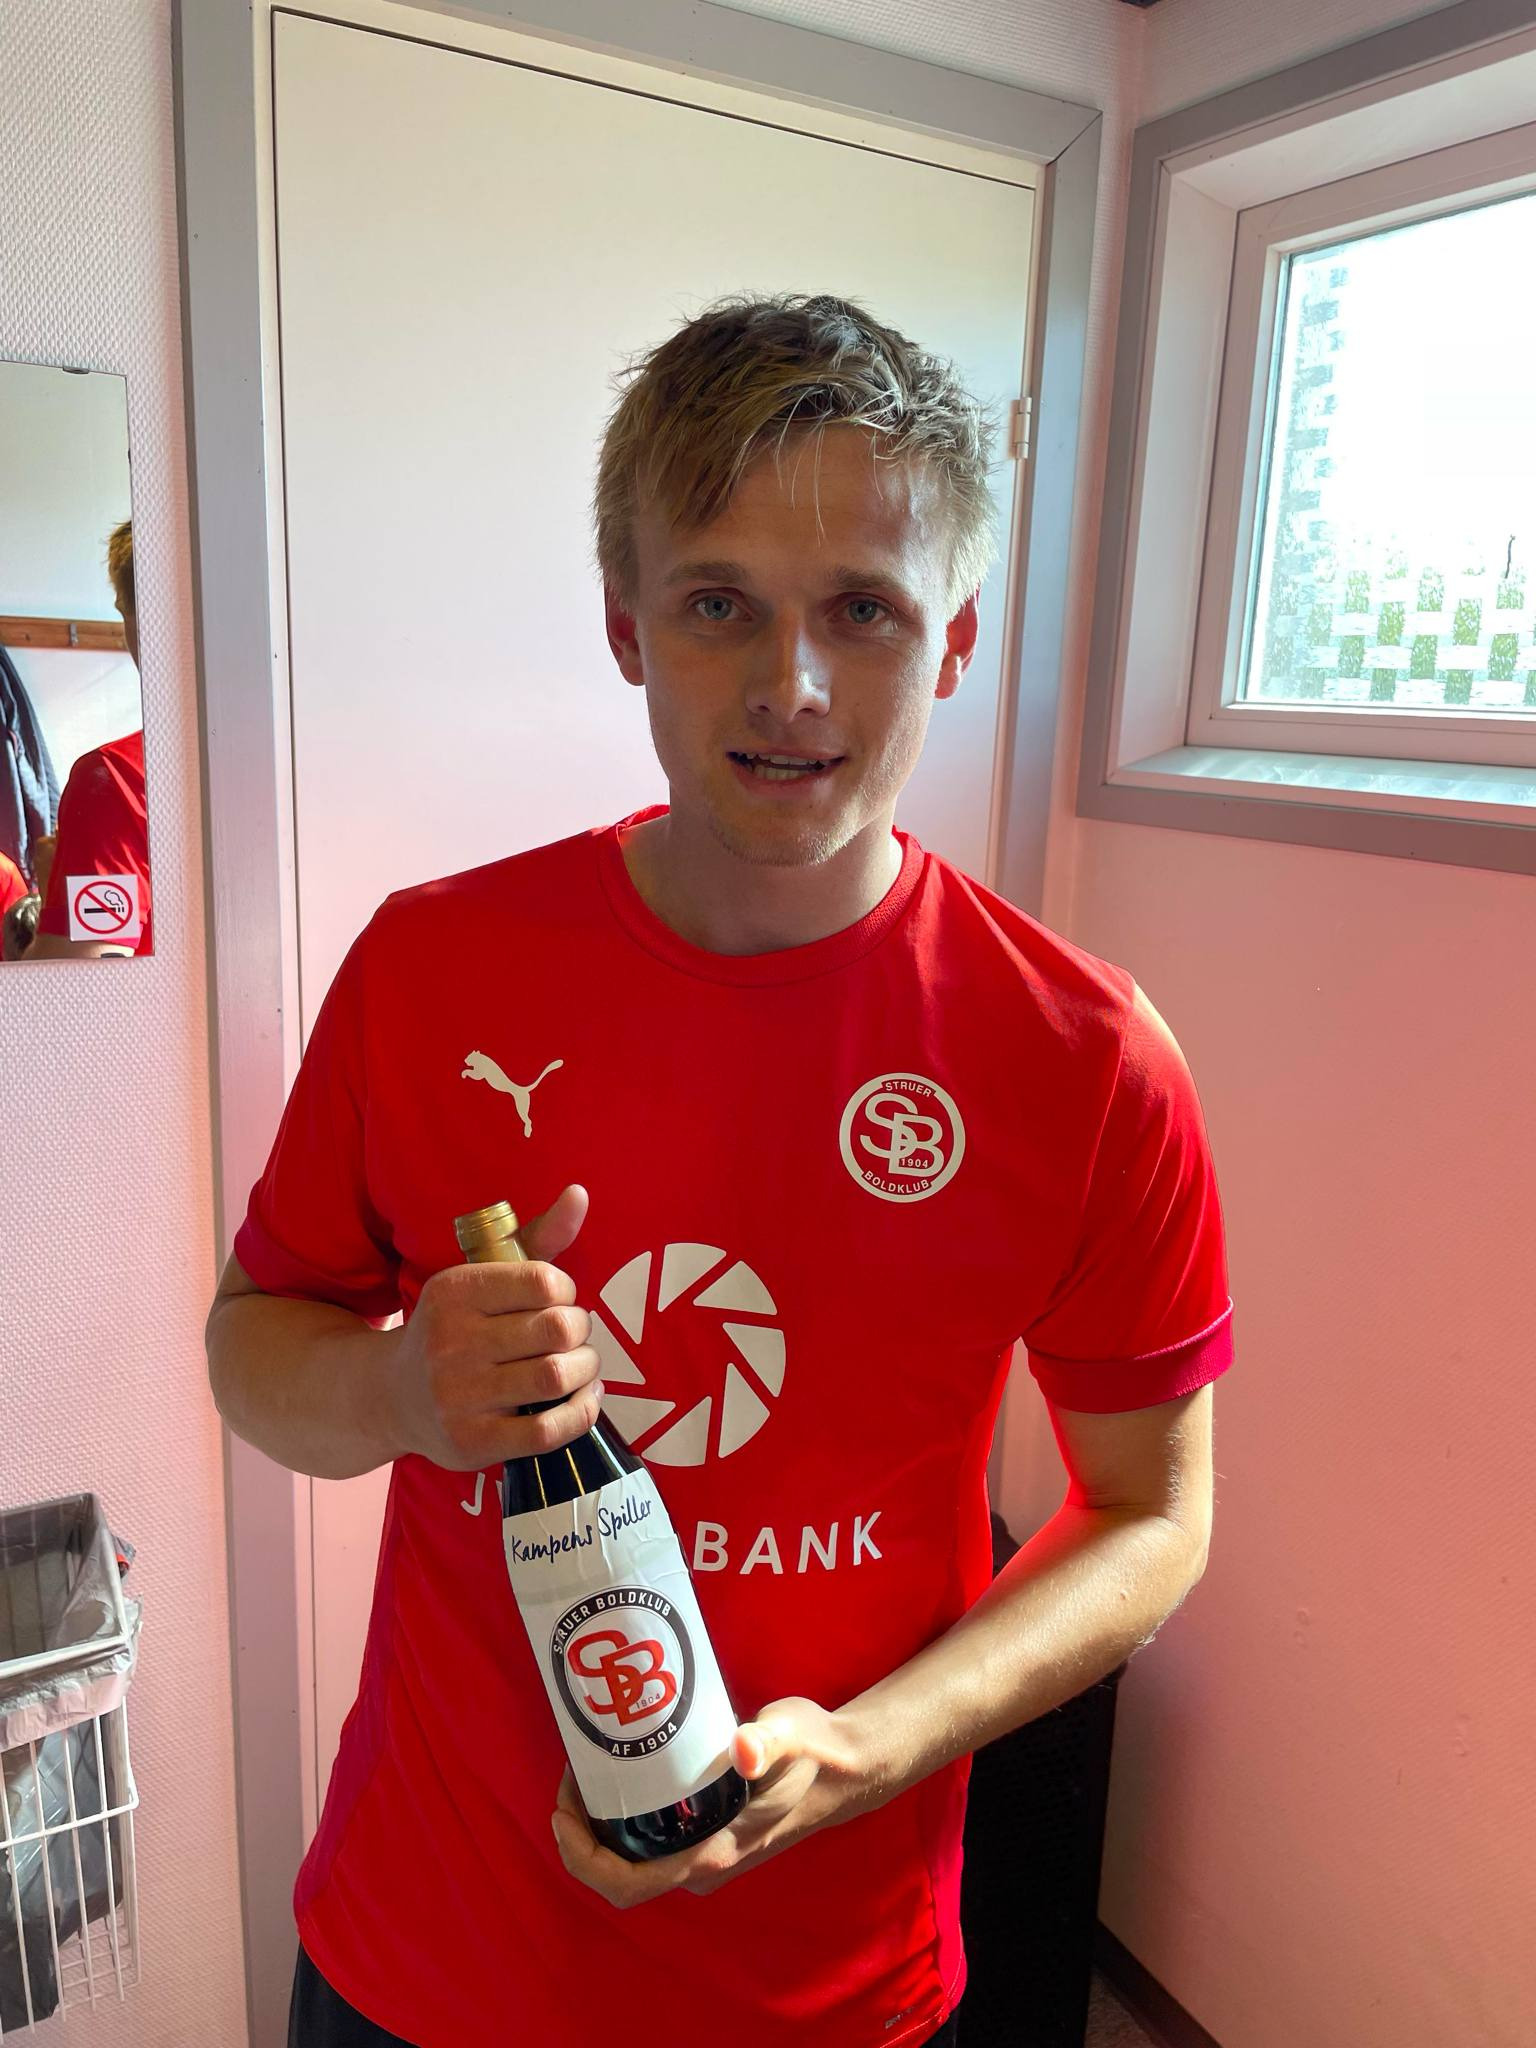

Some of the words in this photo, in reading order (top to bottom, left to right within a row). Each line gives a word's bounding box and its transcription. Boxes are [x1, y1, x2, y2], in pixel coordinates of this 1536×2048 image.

[885, 1081, 932, 1098] STRUER
[900, 1157, 929, 1169] 1904
[863, 1170, 931, 1194] BOLDKLUB
[511, 1524, 593, 1564] Kampens
[597, 1494, 652, 1541] Spiller
[692, 1510, 884, 1576] BANK
[553, 1604, 591, 1655] STRUER
[595, 1590, 671, 1617] BOLDKLUB
[635, 1692, 661, 1709] 1904
[611, 1743, 631, 1756] AF
[639, 1721, 678, 1754] 1904
